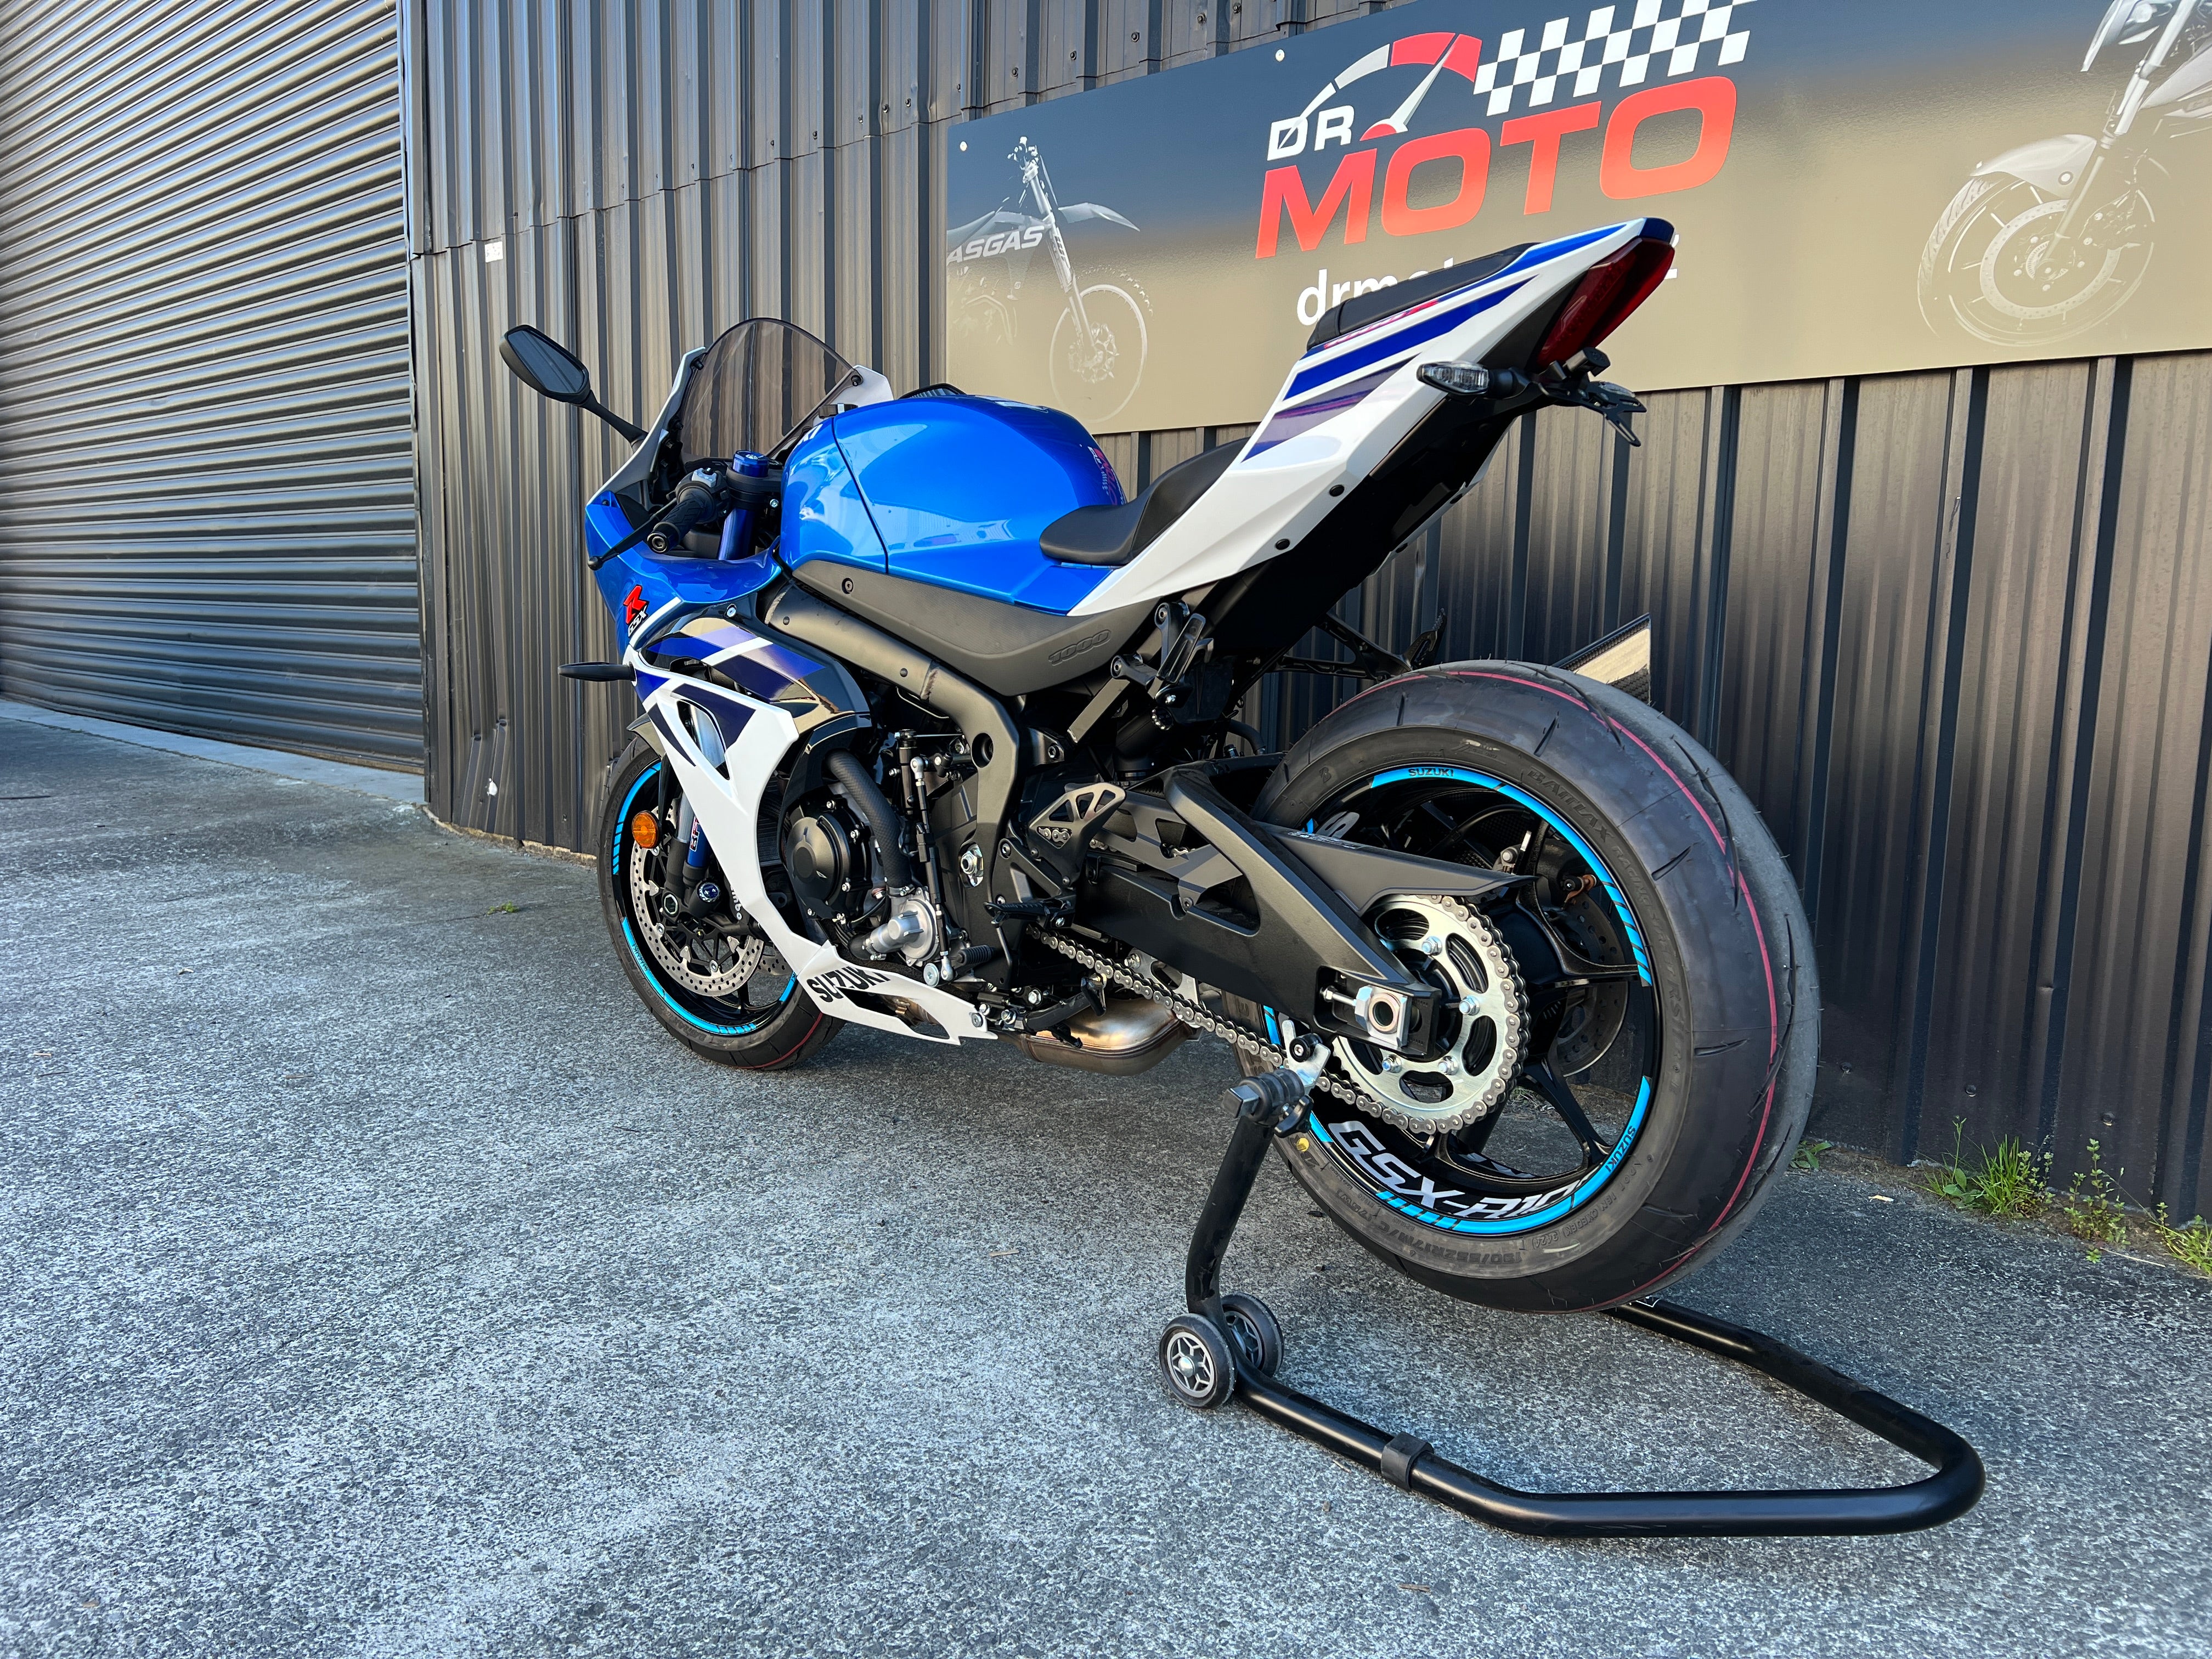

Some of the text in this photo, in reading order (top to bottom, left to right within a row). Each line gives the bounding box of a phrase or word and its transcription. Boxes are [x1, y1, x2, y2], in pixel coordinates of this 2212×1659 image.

[1268, 105, 1355, 161] DR
[1255, 76, 1737, 259] MOTO
[1048, 629, 1111, 665] 1000
[1408, 768, 1454, 777] SUZUKI
[1527, 766, 1615, 843] BATTLAX
[806, 966, 891, 1002] SUZUKI
[1605, 1125, 1637, 1173] SUZUKI
